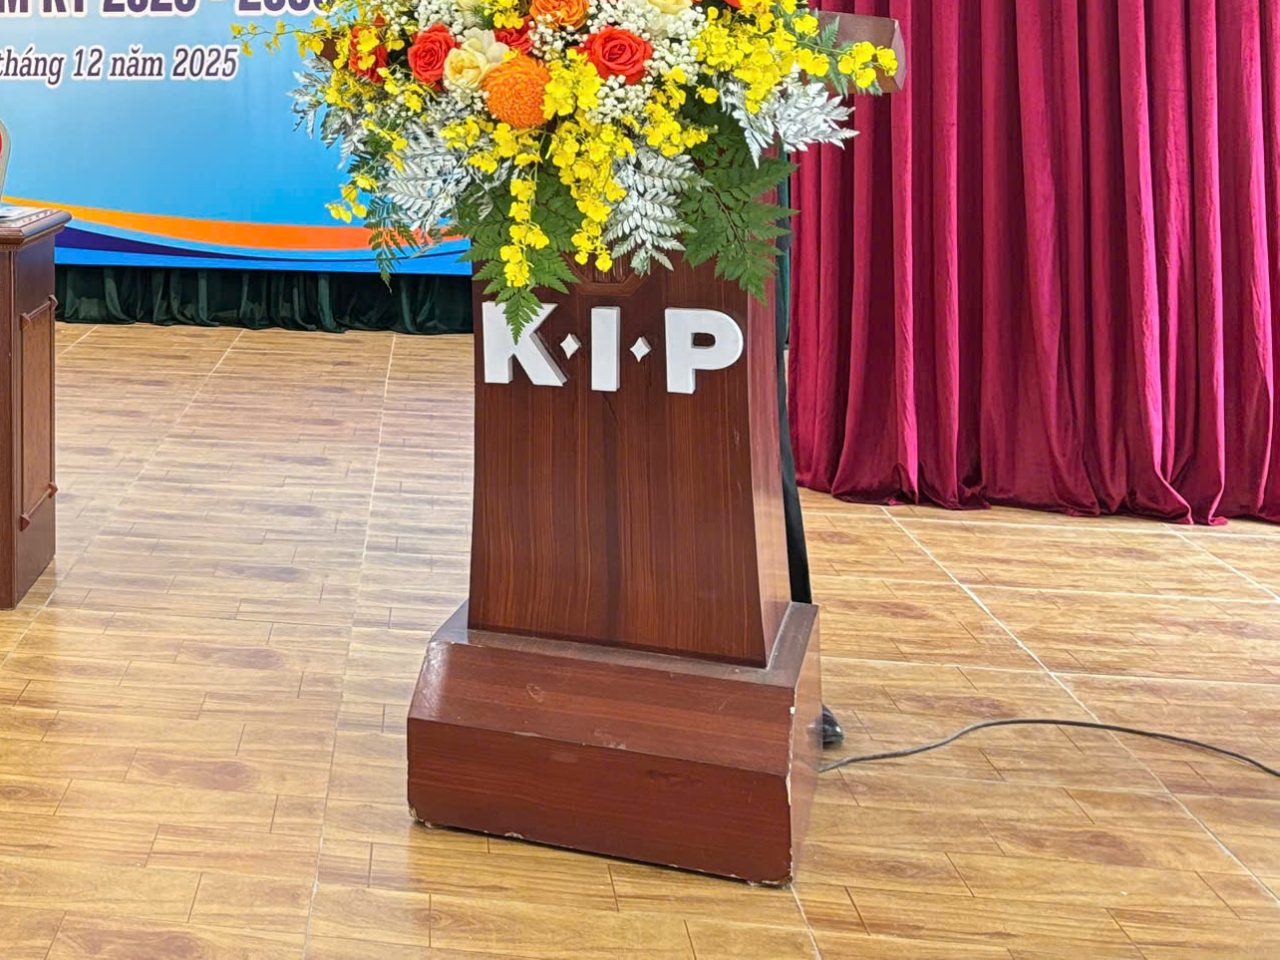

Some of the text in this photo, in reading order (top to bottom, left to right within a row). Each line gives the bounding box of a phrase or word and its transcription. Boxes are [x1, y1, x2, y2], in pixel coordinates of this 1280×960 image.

[73, 48, 103, 77] 12
[109, 46, 163, 77] năm
[172, 48, 238, 77] 2025
